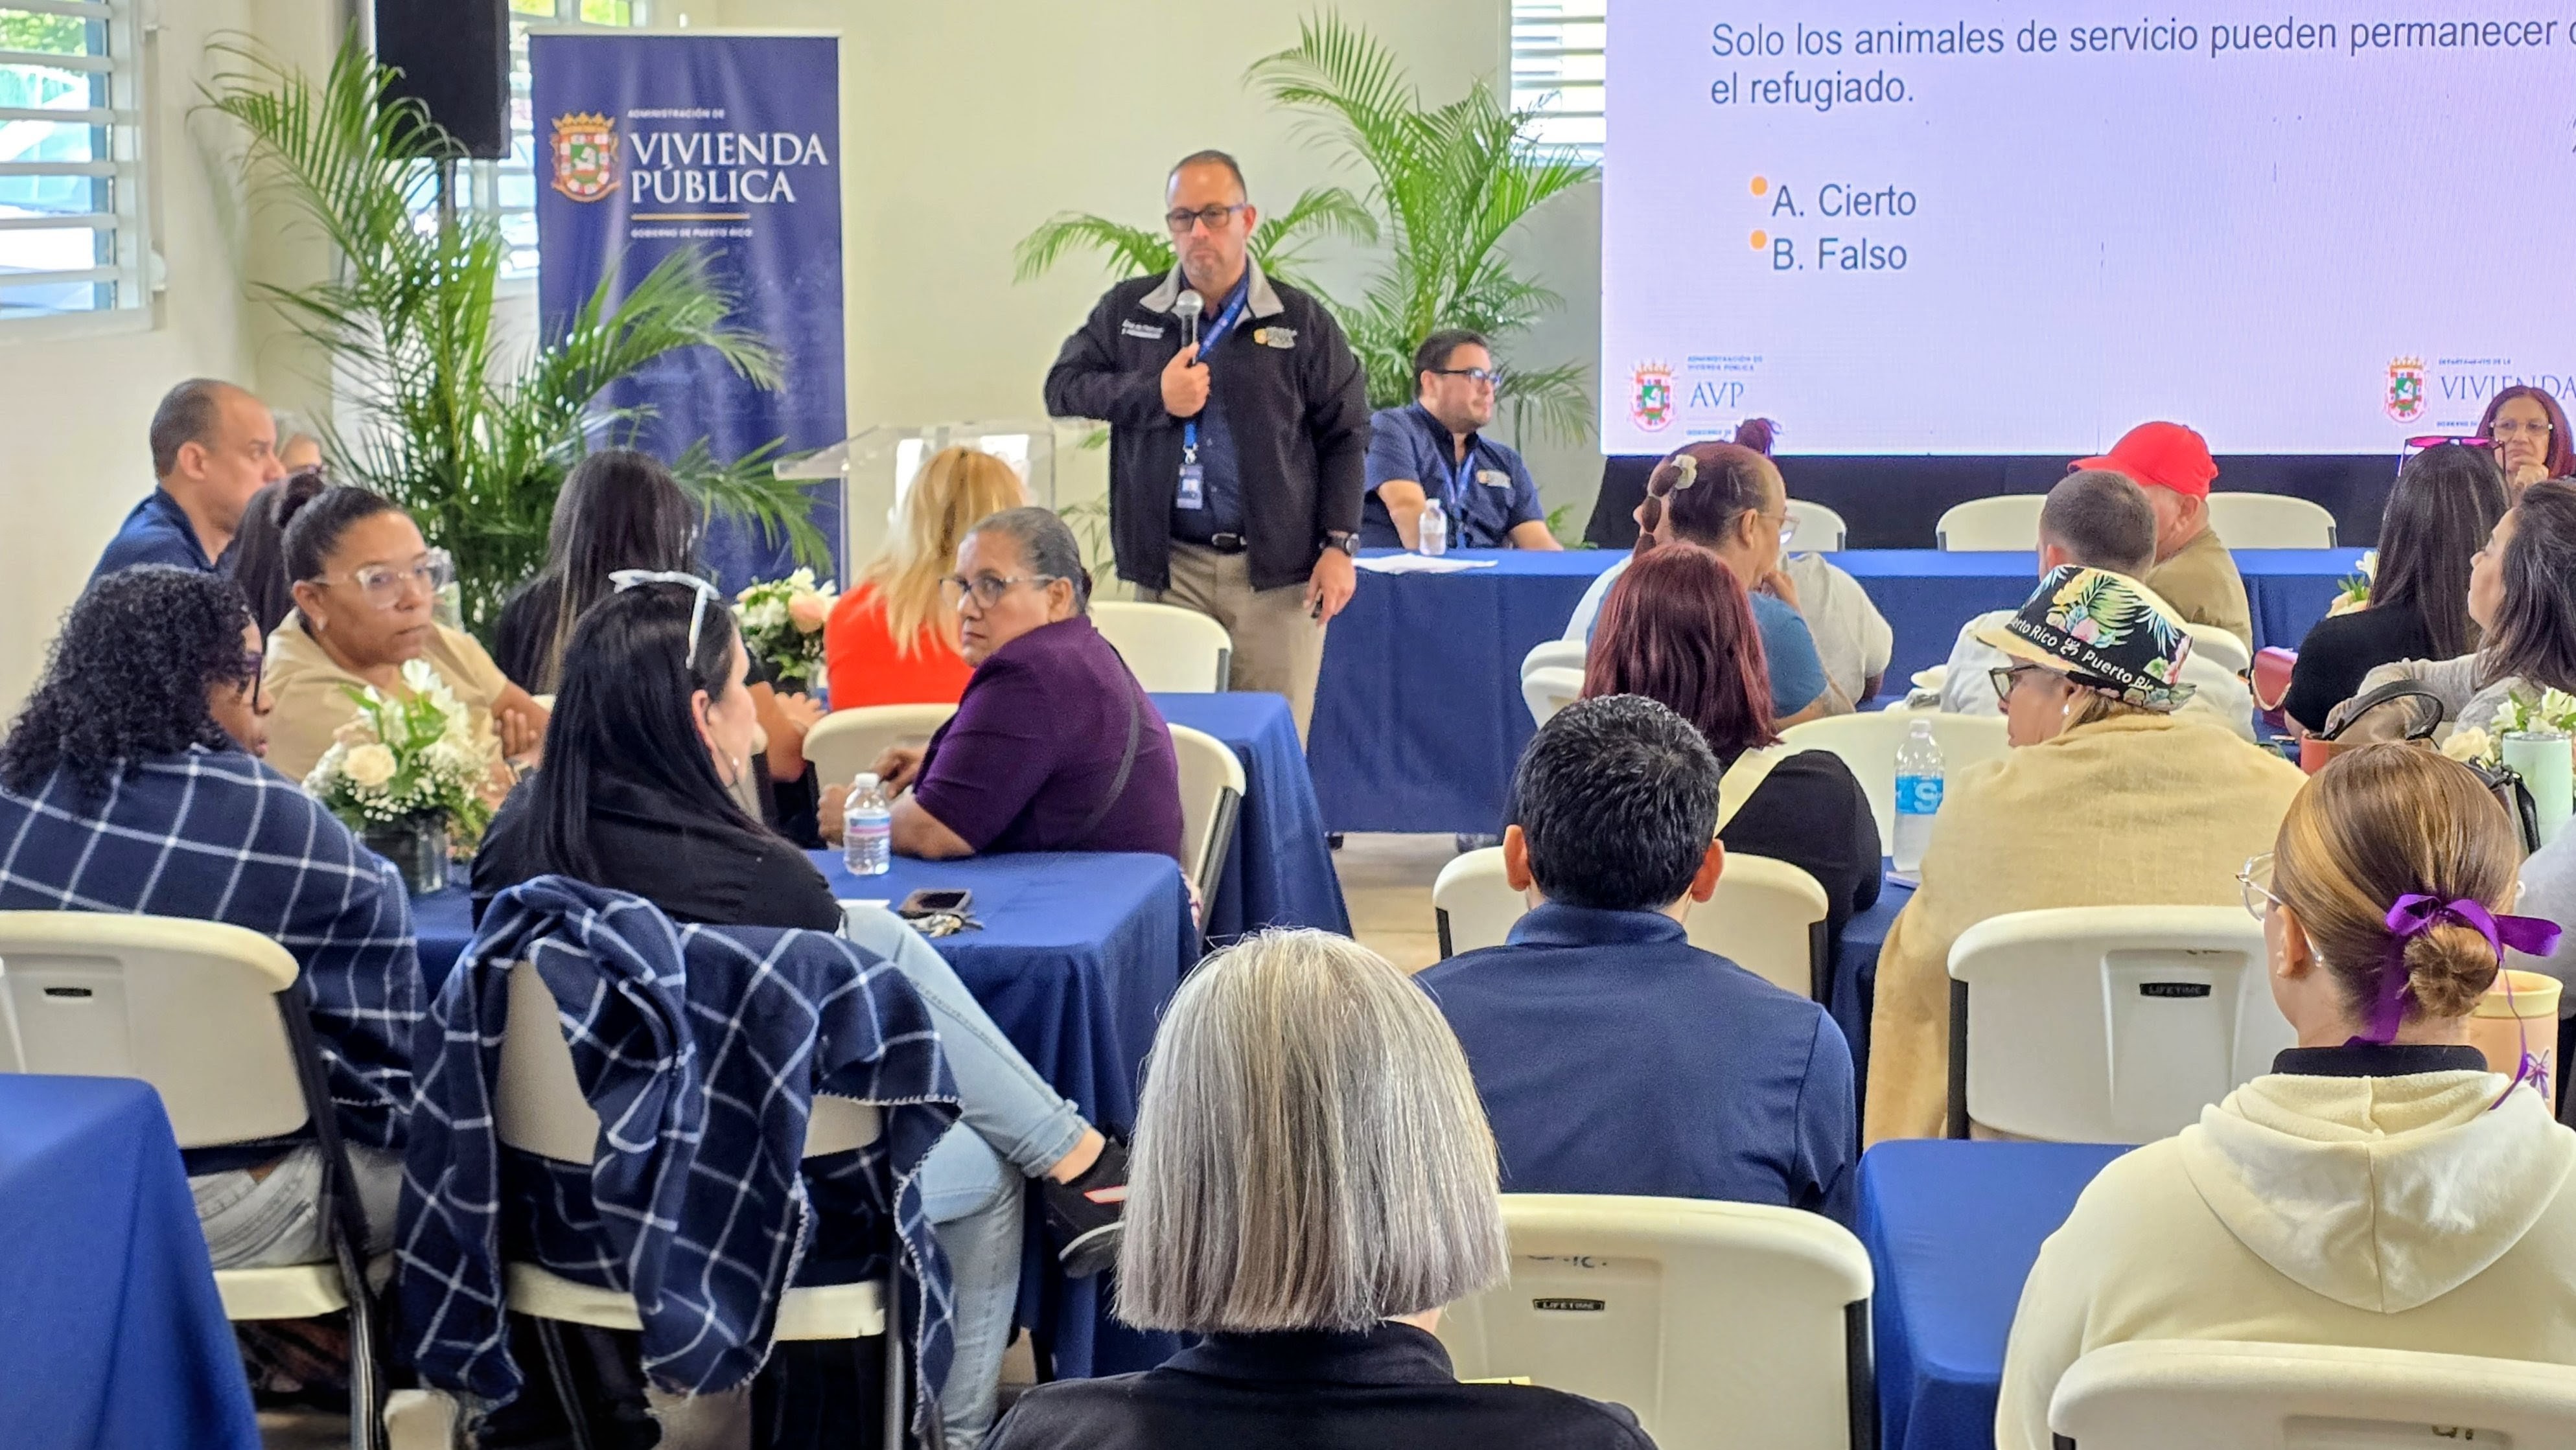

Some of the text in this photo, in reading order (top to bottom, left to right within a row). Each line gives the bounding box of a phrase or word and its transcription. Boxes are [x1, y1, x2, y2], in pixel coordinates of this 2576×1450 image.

[1712, 22, 1784, 56] Solo
[1797, 21, 1842, 56] los
[1855, 20, 2004, 54] animales
[2017, 19, 2058, 53] de
[2070, 17, 2198, 52] servicio
[2211, 16, 2336, 58] pueden
[2350, 21, 2557, 57] permanecer
[1711, 69, 1914, 112] el refugiado.
[628, 132, 830, 166] VIVIENDA
[631, 163, 796, 204] PÚBLICA
[1772, 183, 1917, 217] A. Cierto
[1773, 237, 1907, 270] B. Falso
[1689, 381, 1745, 408] AVP
[2012, 617, 2031, 634] erto
[2029, 625, 2058, 647] Rico
[2081, 649, 2133, 684] Puerto
[2149, 984, 2201, 995] LIFETIME
[1542, 1300, 1594, 1309] LIFETIME
